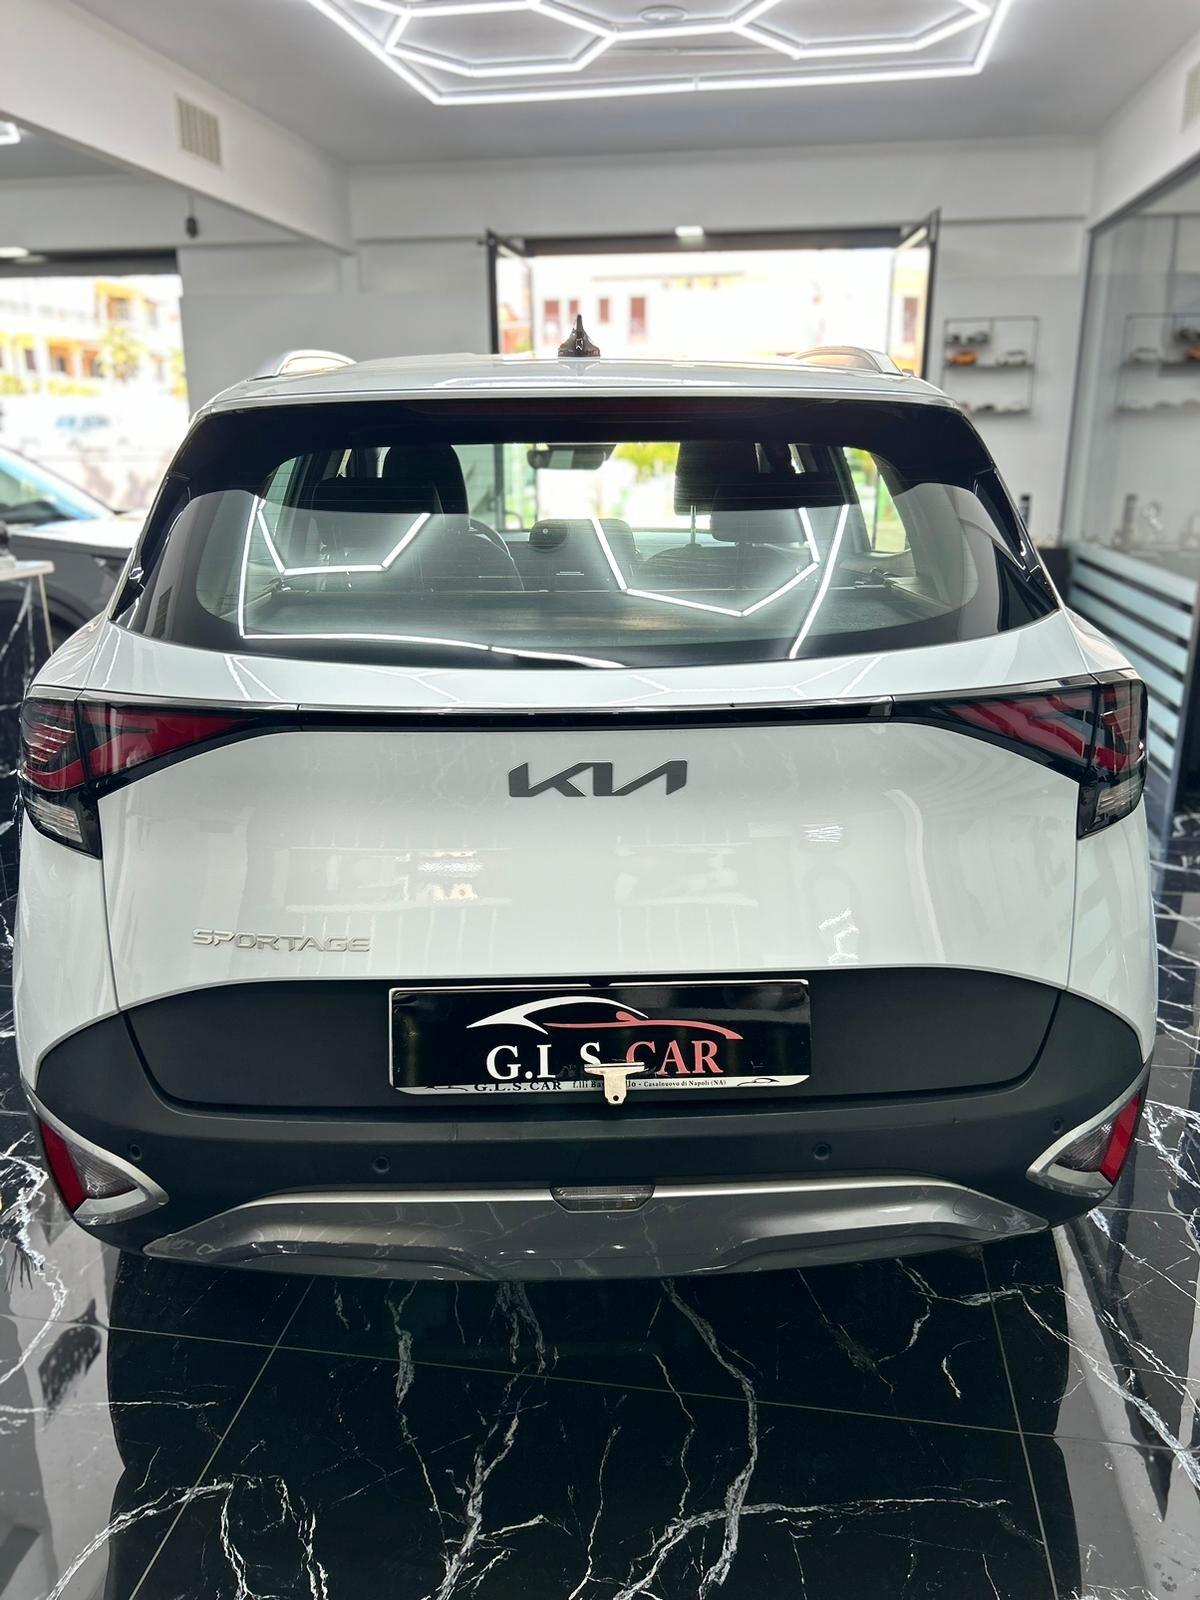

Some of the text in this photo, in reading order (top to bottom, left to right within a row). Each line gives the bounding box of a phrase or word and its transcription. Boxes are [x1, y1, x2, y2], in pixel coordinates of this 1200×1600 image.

[508, 760, 688, 798] KIA
[192, 927, 371, 953] SPORTAGE
[626, 1039, 724, 1076] CAR
[474, 1080, 562, 1093] G.L.S.CAR
[689, 1080, 710, 1088] Napoli
[711, 1079, 727, 1087] (NA)
